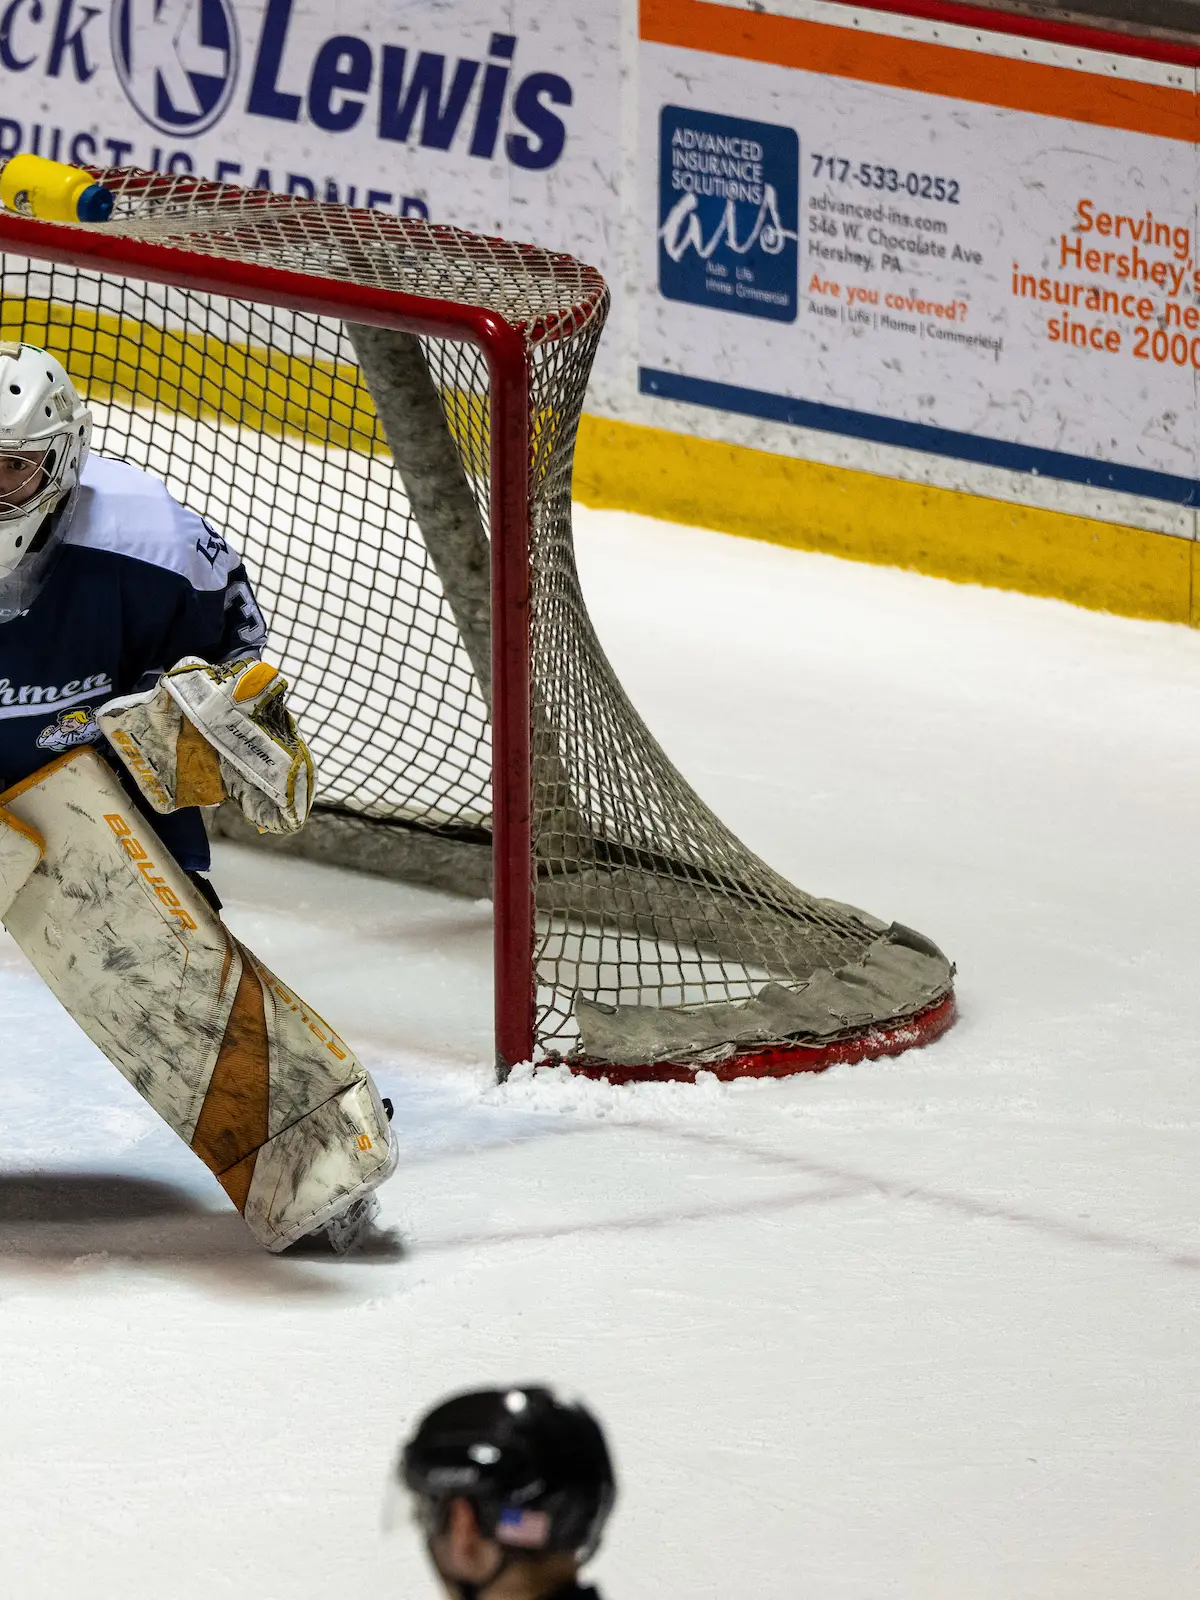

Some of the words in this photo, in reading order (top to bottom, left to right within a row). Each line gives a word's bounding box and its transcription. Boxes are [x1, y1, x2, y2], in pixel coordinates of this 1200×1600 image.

[244, 0, 574, 172] Lewis
[672, 127, 764, 162] ADVANCED
[672, 149, 764, 184] INSURANCE
[672, 169, 764, 205] SOLUTIONS
[811, 153, 961, 205] 717-533-0252
[809, 192, 948, 234] advanced-ins.com
[1076, 198, 1190, 261] Serving
[867, 227, 947, 258] Chocolate
[952, 243, 983, 265] Ave
[809, 273, 840, 297] Are
[847, 286, 880, 305] you
[885, 291, 968, 322] covered?
[1012, 262, 1155, 321] insurance
[809, 300, 837, 318] Auto
[848, 307, 871, 325] Life
[881, 314, 918, 335] Home
[1047, 311, 1121, 353] since
[1133, 325, 1200, 370] 2000
